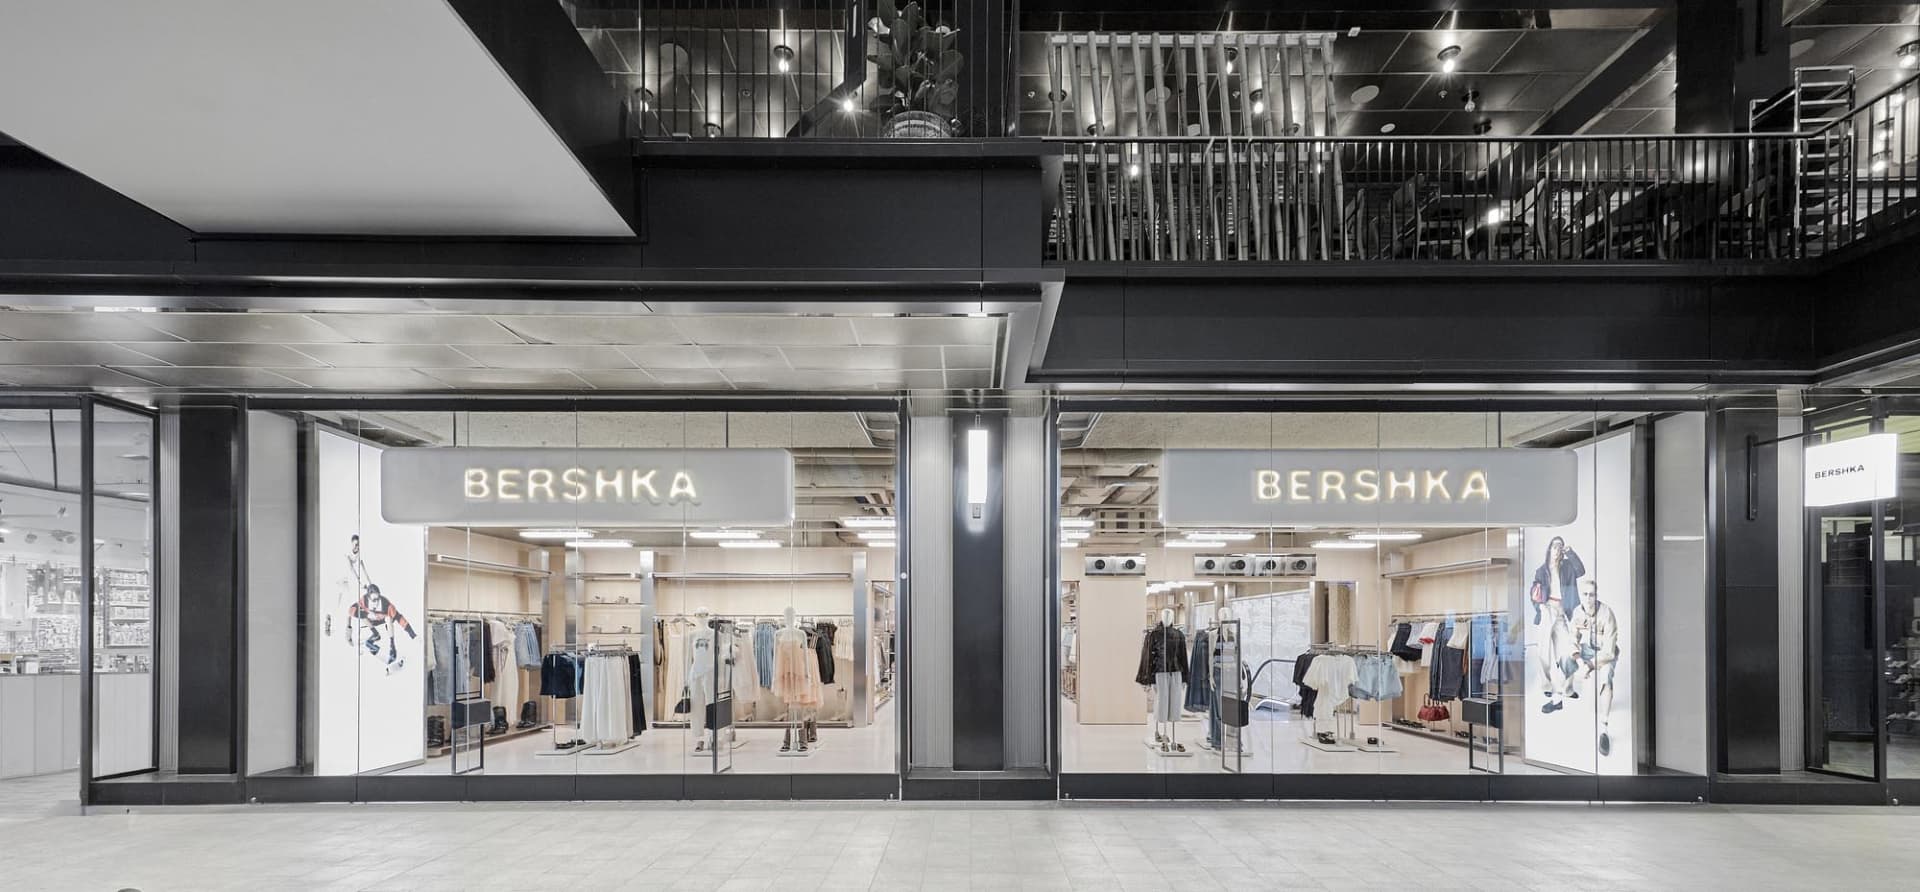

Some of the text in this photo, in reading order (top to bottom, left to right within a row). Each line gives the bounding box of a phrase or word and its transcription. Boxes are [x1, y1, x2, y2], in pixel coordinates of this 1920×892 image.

[463, 467, 698, 501] BERSHKA
[1256, 469, 1490, 501] BERSHKA
[1814, 464, 1865, 479] BERSHKA
